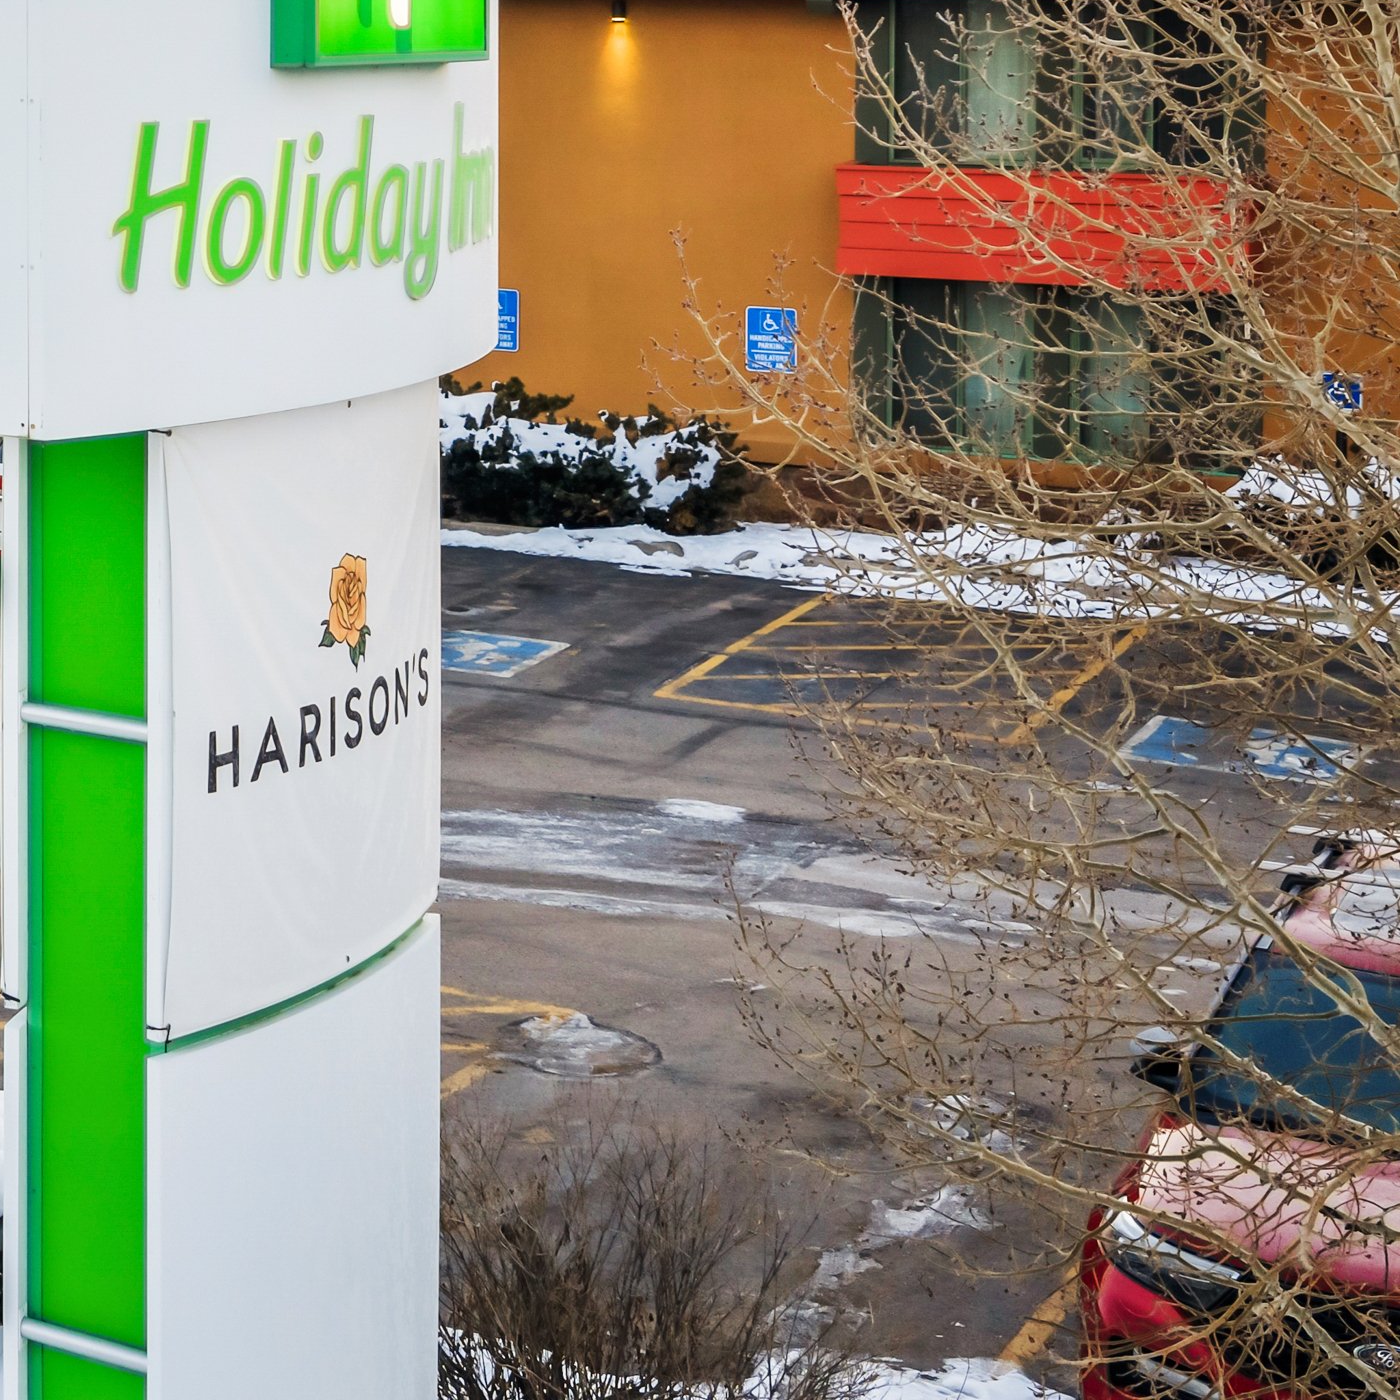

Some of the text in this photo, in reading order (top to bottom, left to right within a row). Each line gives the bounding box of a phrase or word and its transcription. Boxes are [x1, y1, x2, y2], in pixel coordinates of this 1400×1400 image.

[109, 101, 494, 299] Holiday Inn
[207, 647, 429, 794] HARISON'S
